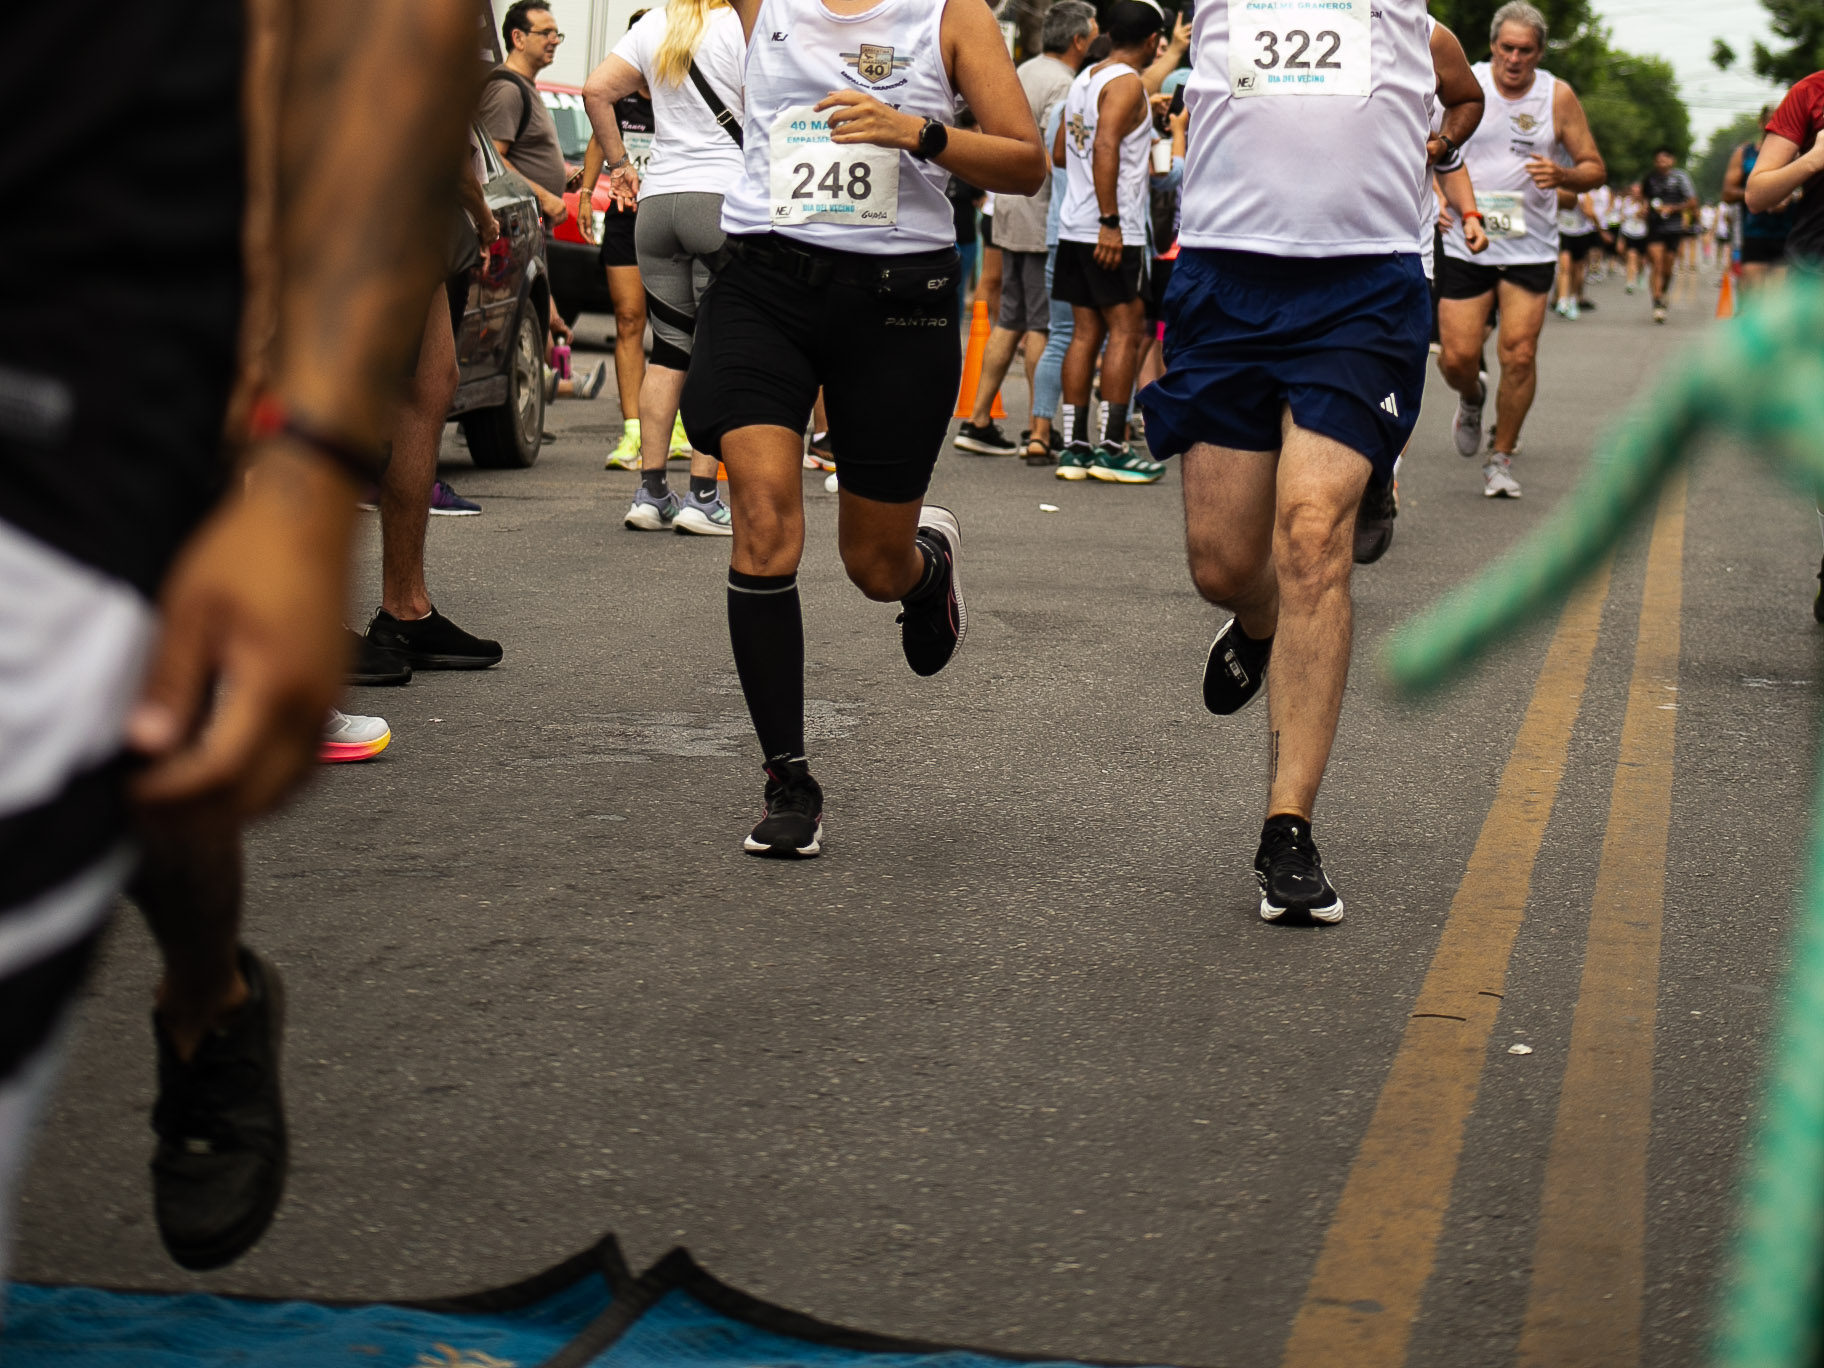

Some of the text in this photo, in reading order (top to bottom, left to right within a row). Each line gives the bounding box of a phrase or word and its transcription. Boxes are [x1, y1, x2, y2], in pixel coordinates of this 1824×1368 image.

[1246, 2, 1293, 10] EMPALME
[1254, 29, 1341, 70] 322
[864, 64, 885, 76] 40
[1282, 75, 1295, 83] DEL
[1297, 75, 1325, 83] VECINO
[790, 120, 806, 130] 40
[791, 161, 872, 200] 248
[816, 204, 828, 212] DEL
[829, 204, 855, 212] VECINO
[885, 317, 948, 327] PANTRO
